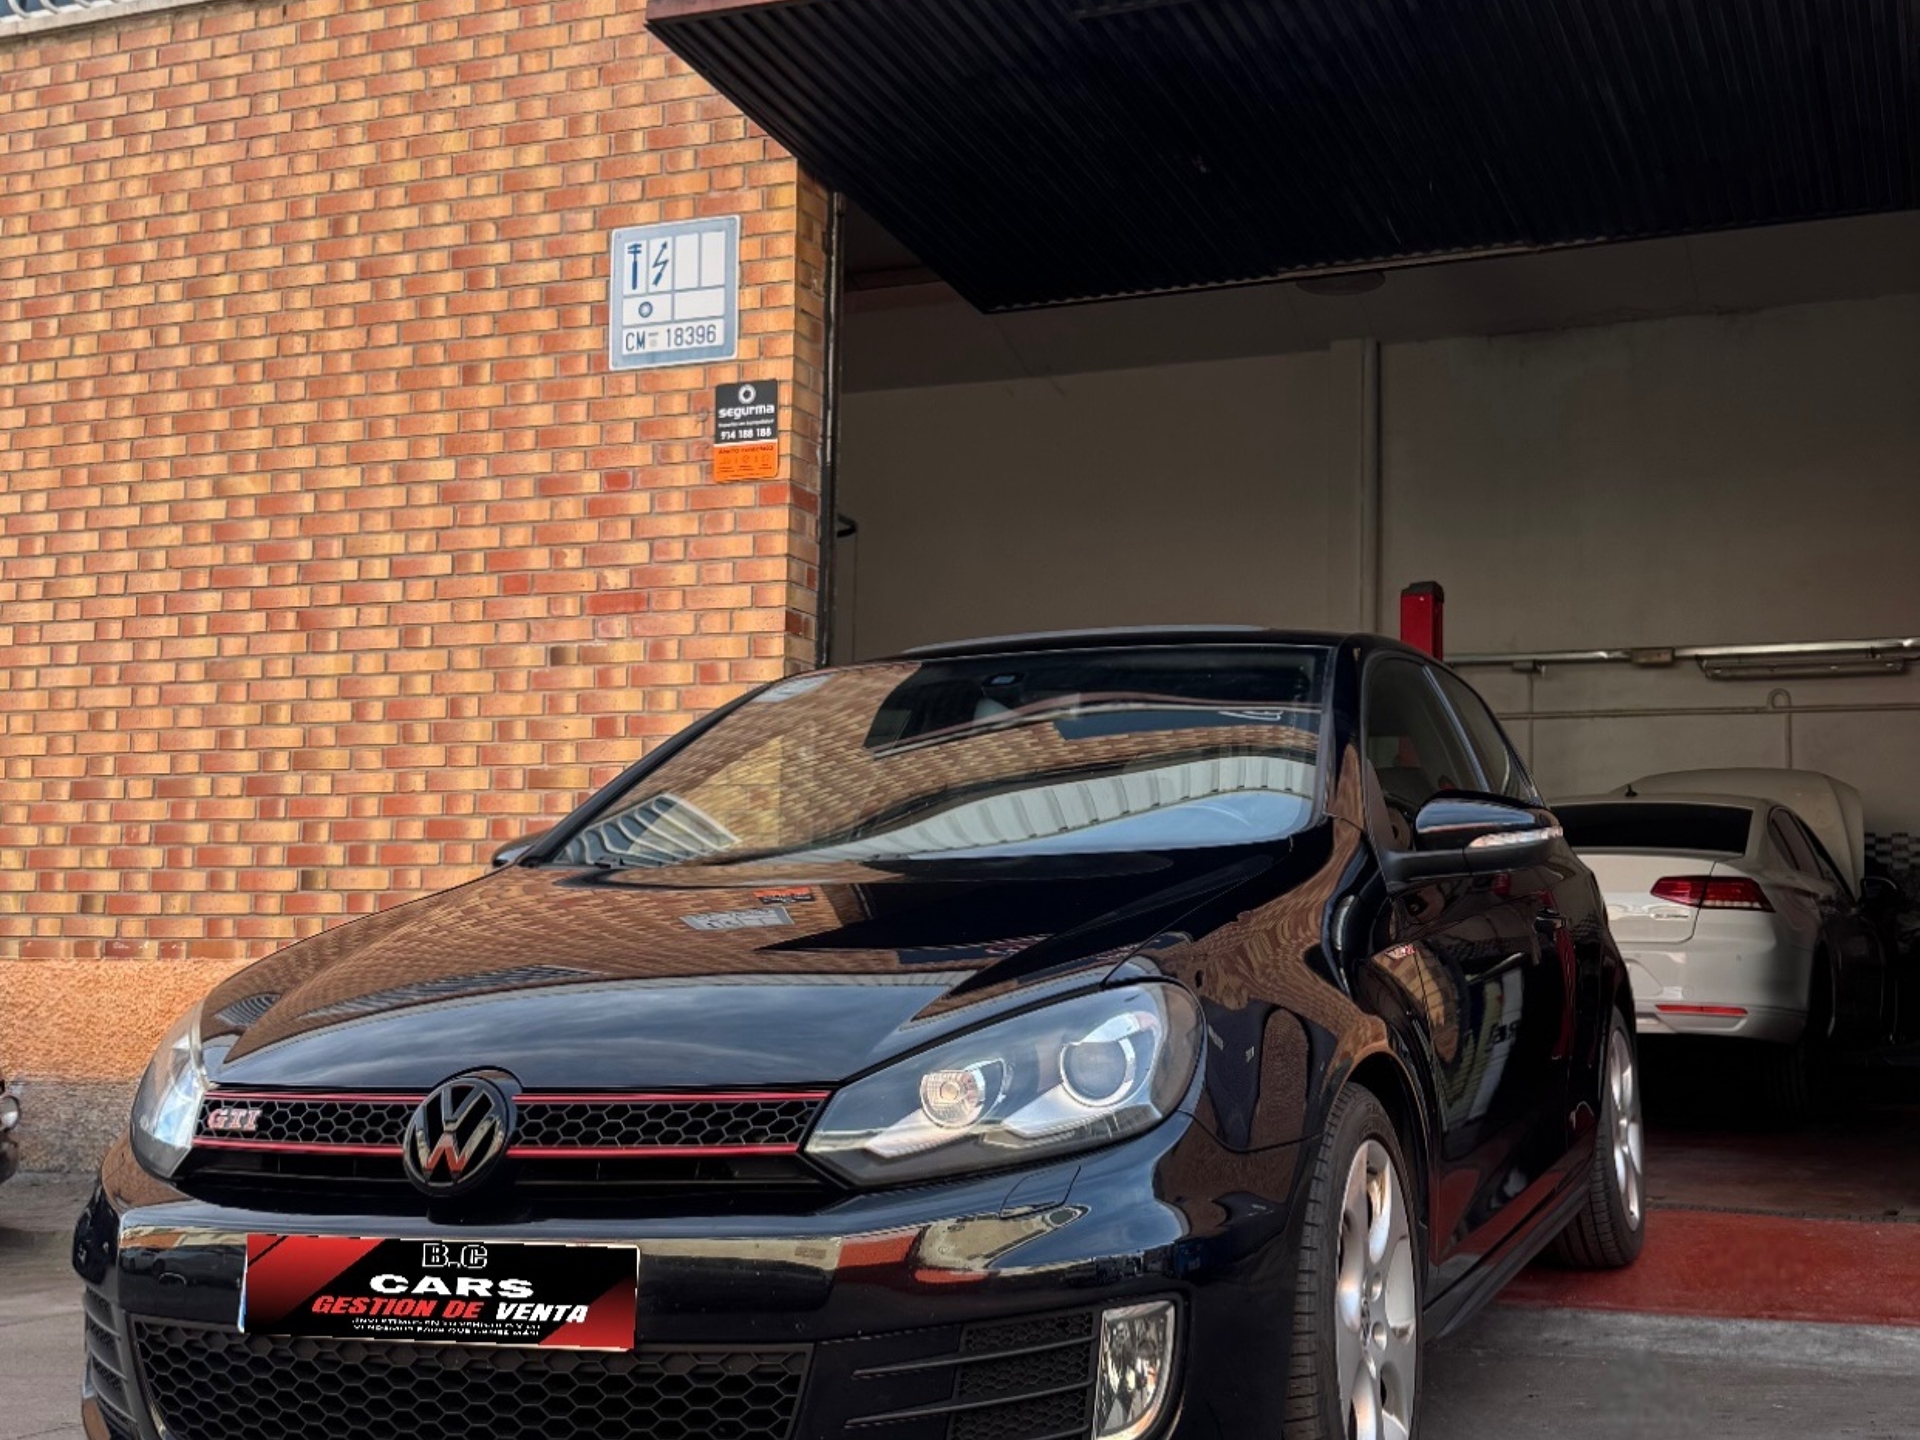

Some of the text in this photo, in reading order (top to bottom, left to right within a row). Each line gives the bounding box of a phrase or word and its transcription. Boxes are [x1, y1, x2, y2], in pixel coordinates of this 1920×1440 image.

[666, 324, 717, 348] 18396
[718, 403, 775, 420] segurma
[207, 1107, 262, 1131] GTI
